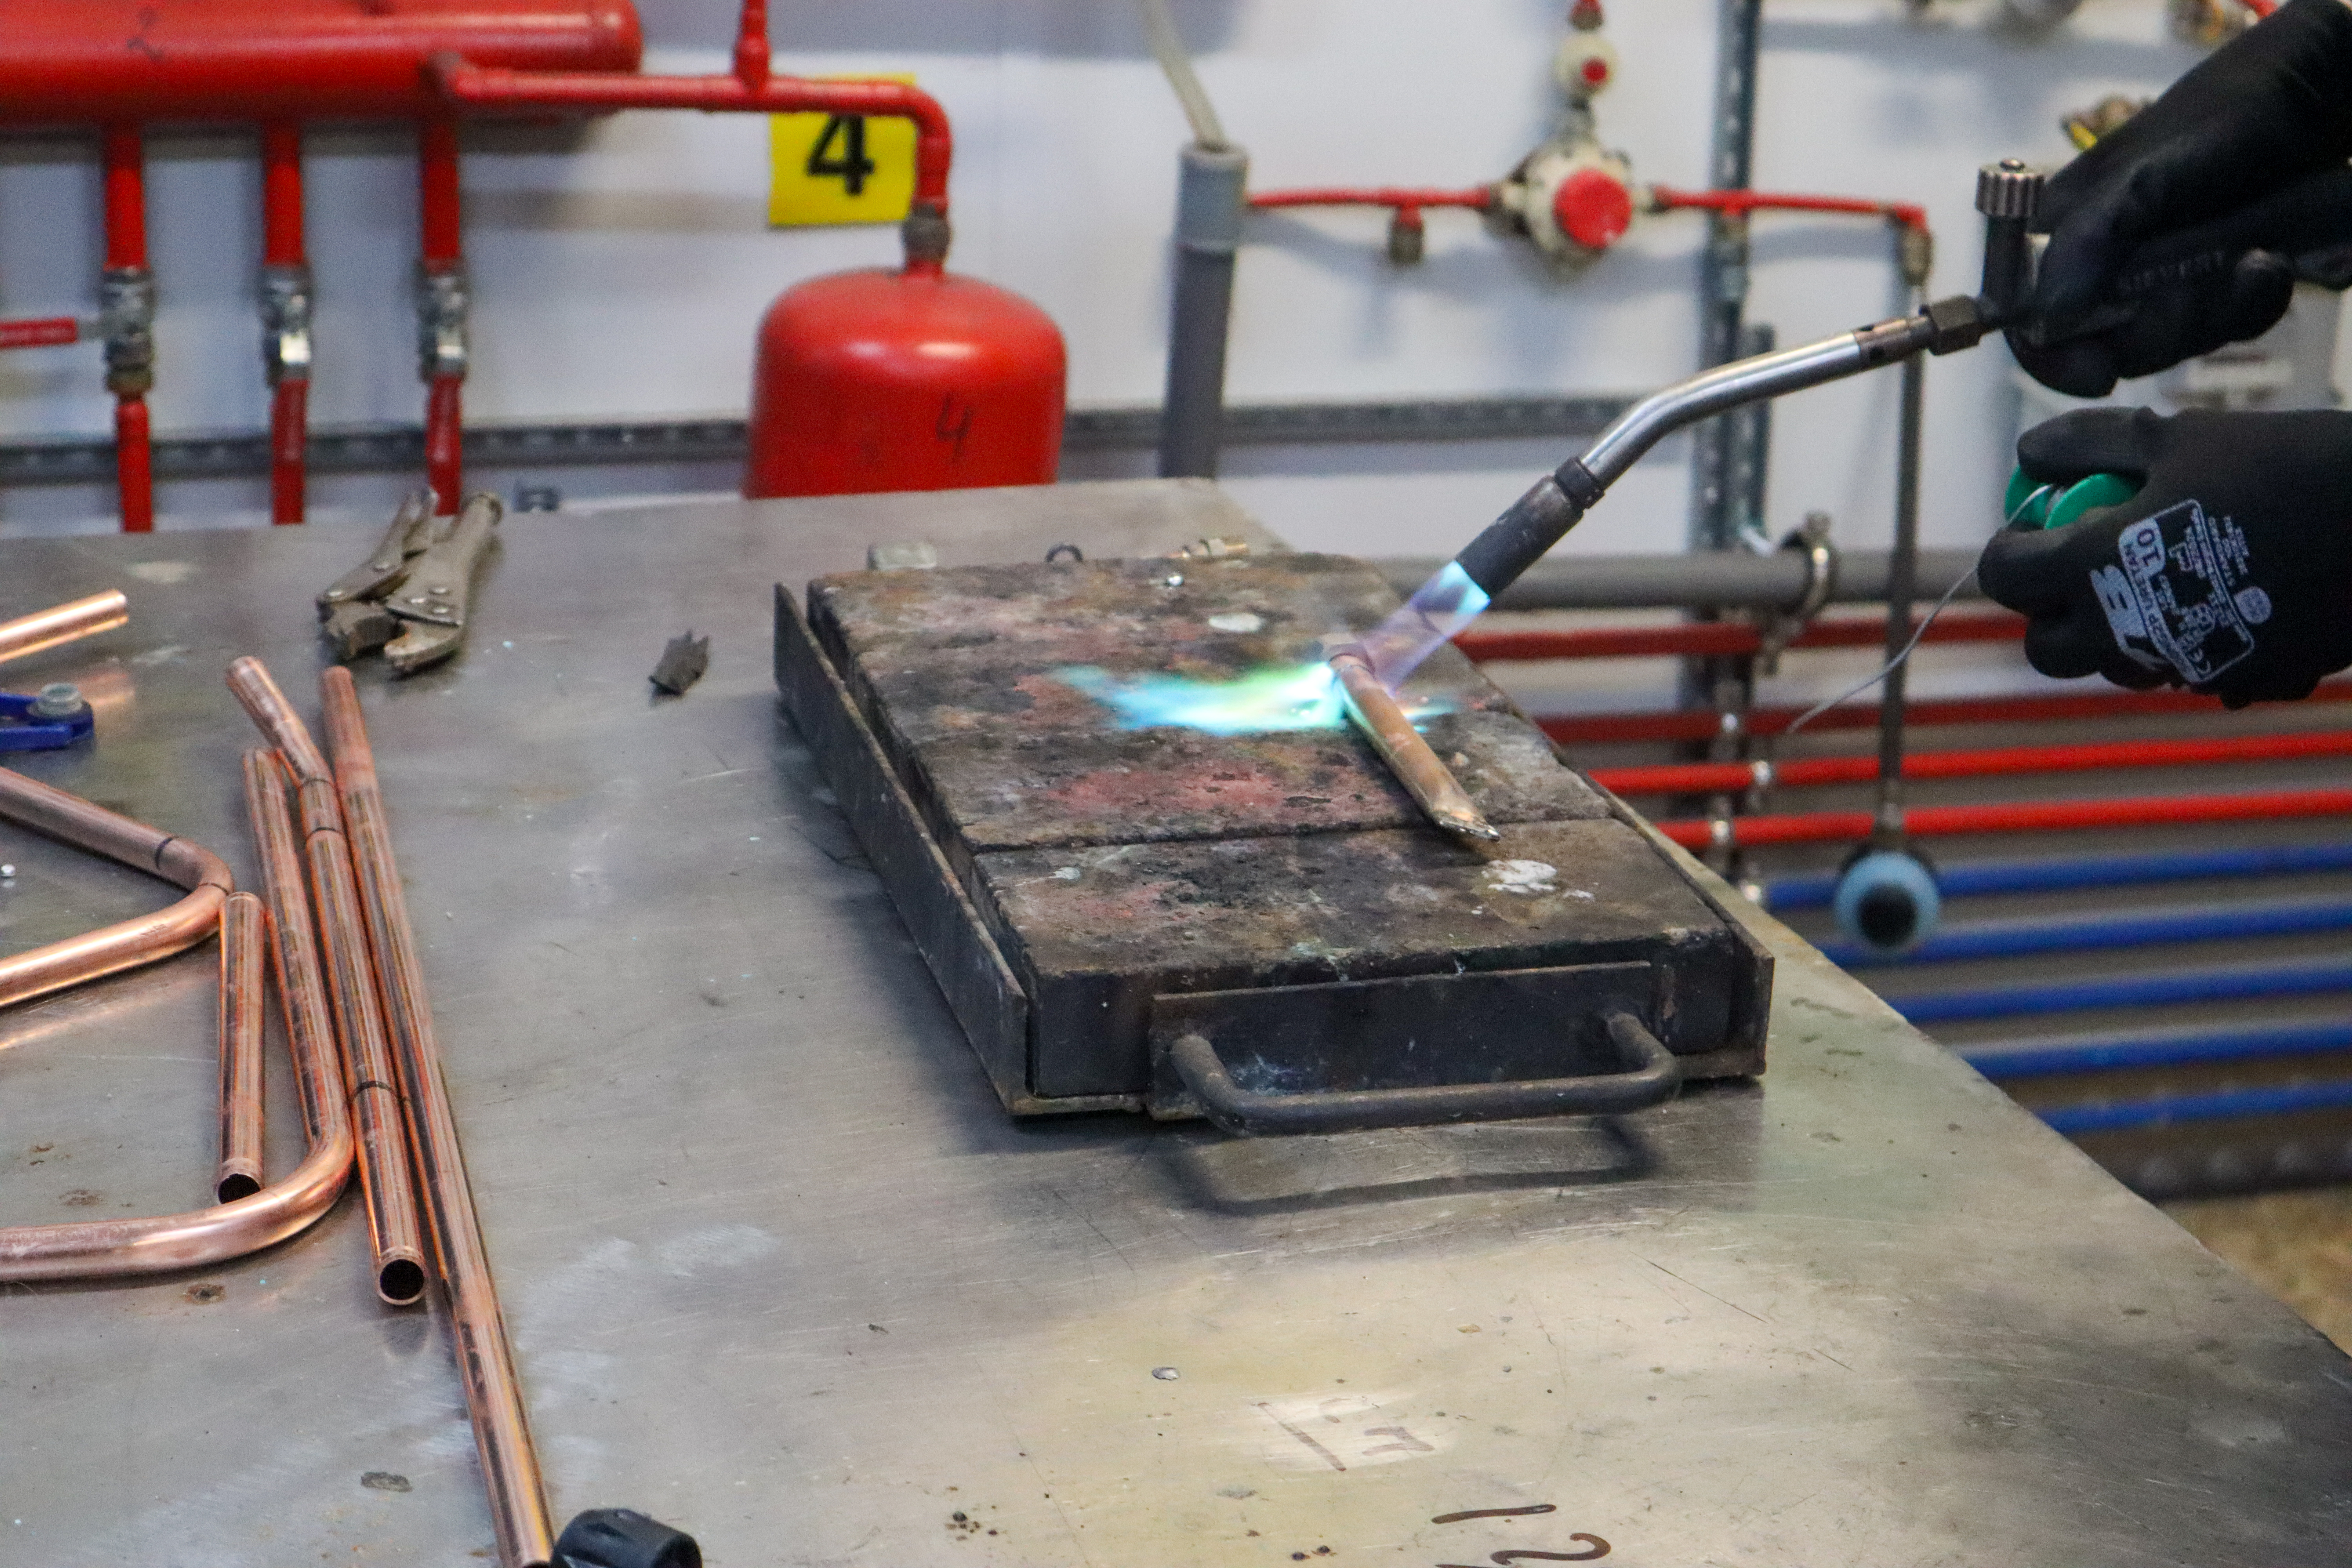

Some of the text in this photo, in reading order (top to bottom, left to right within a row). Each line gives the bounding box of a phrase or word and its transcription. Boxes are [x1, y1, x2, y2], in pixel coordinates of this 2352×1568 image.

[805, 114, 875, 196] 4
[935, 394, 974, 462] 4
[2137, 528, 2162, 567] 10
